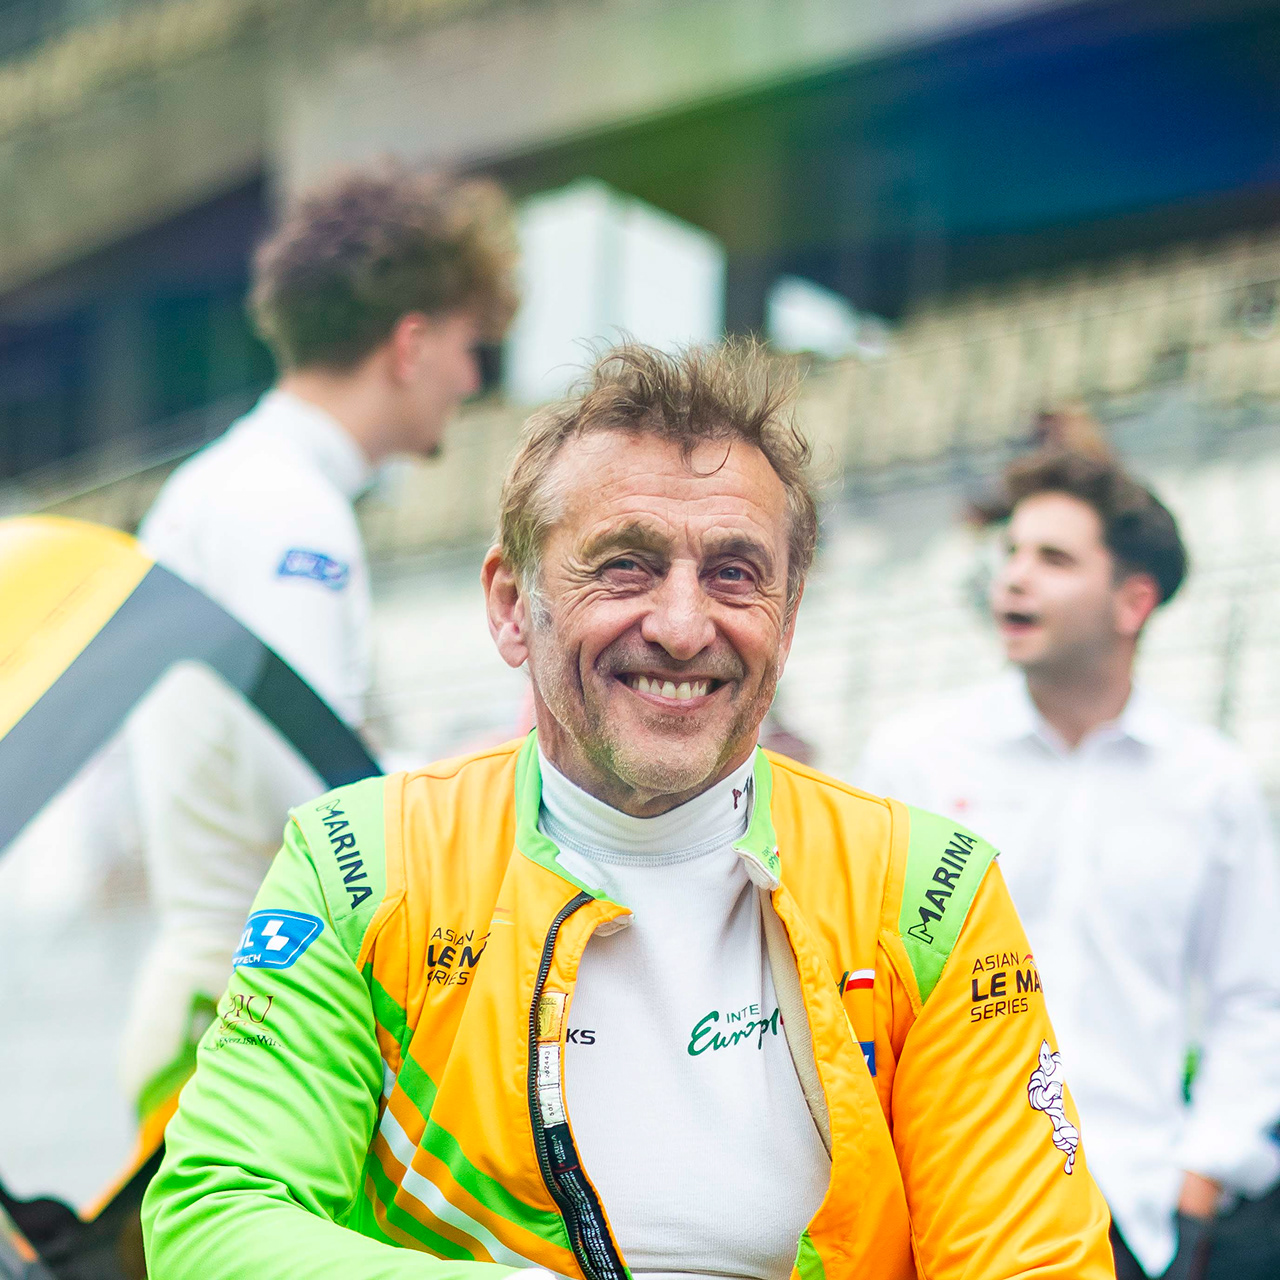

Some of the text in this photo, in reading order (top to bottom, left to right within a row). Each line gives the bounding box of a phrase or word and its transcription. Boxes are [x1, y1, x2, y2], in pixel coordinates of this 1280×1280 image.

[315, 798, 373, 910] MARINA
[907, 831, 978, 945] MARINA
[972, 951, 1020, 975] ASIAN
[971, 968, 1044, 1003] LE MA
[726, 1003, 760, 1024] INTE
[970, 997, 1029, 1023] SERIES
[566, 1027, 596, 1046] KS
